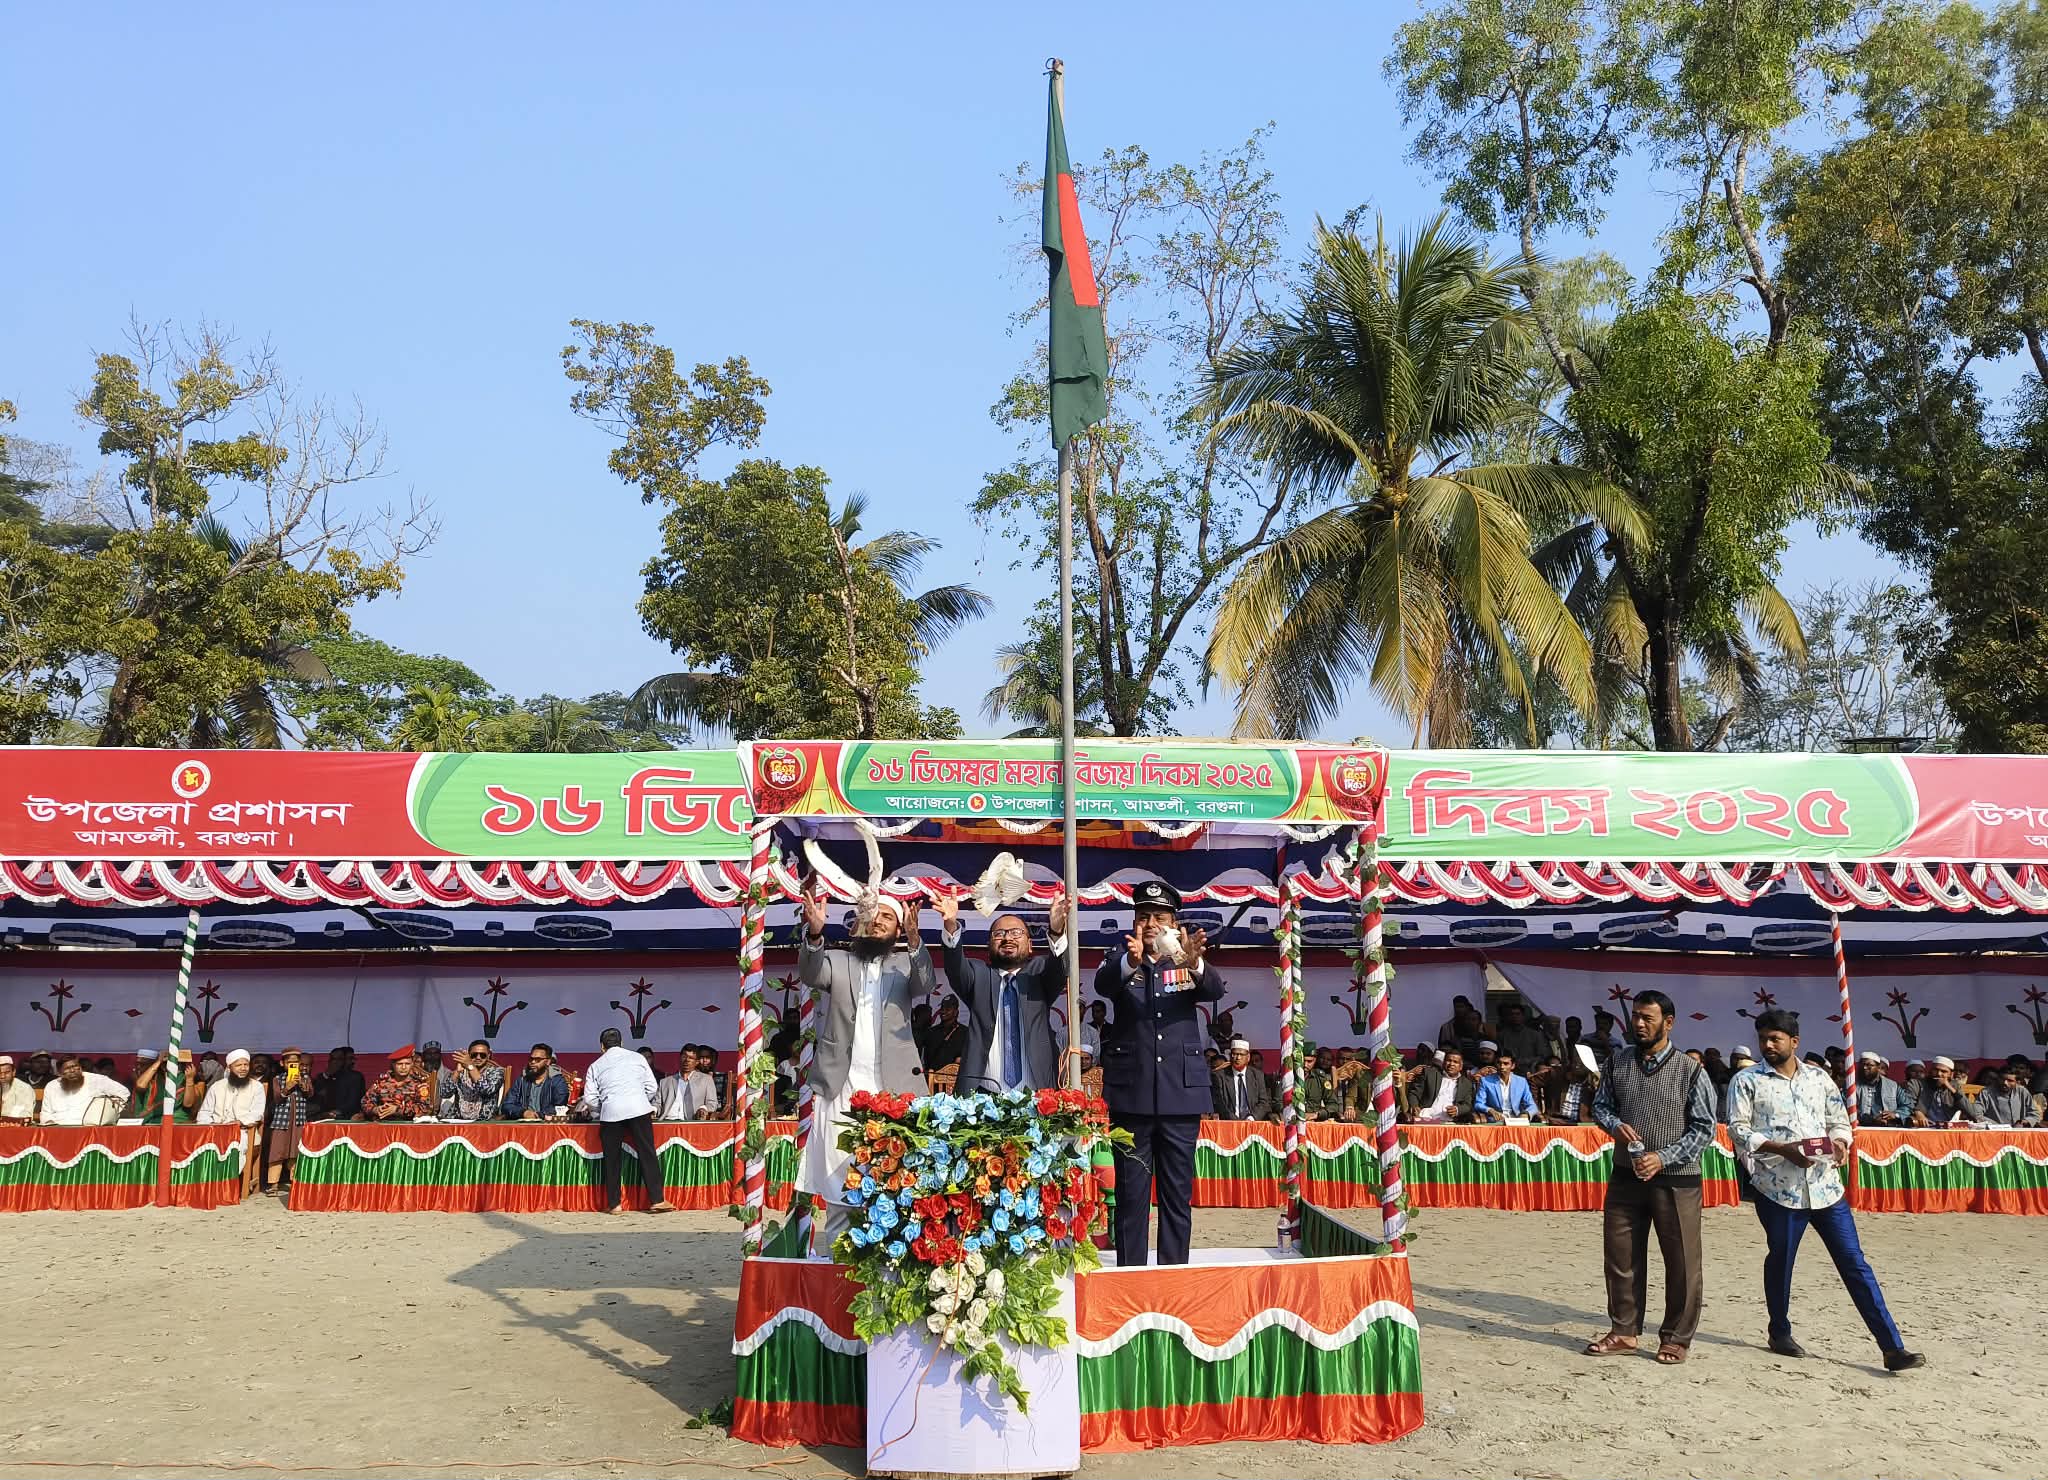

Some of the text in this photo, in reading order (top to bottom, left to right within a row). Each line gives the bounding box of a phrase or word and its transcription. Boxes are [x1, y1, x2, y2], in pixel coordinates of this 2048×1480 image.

[868, 758, 904, 783] ১৬
[908, 749, 1000, 787] ডিসেম্বর
[1140, 752, 1201, 788] দিবস
[1205, 761, 1274, 789] ২০২৫
[21, 795, 354, 826] উপজেলা প্রশাসন
[480, 785, 603, 836] ১৬
[990, 794, 1056, 811] উপজেলা
[1122, 796, 1190, 816] আমতলী,
[1196, 801, 1246, 815] বরগুনা
[1403, 769, 1611, 837] দিবস
[1630, 788, 1852, 840] ২০২৫
[74, 826, 186, 848] আমতলী,
[195, 830, 281, 847] বরগুনা
